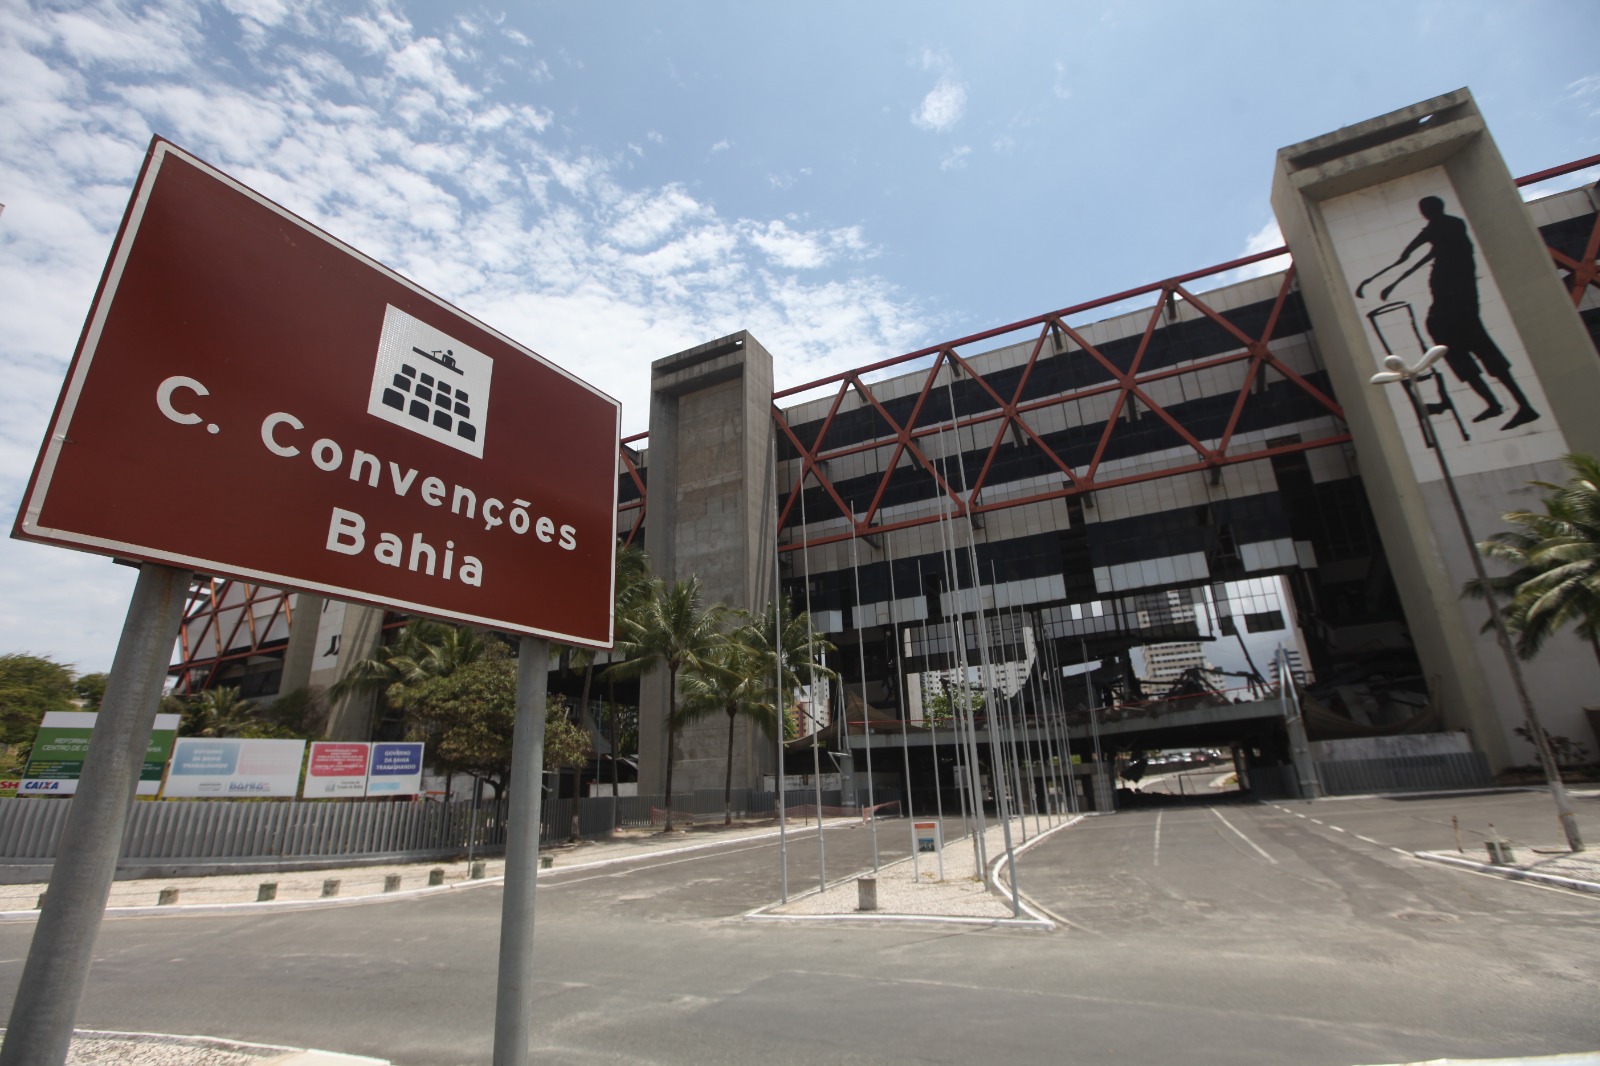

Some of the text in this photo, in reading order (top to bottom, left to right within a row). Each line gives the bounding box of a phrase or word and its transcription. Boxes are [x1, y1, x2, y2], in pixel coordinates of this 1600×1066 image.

[156, 375, 577, 551] C. Convenções
[325, 506, 483, 587] Bahia
[25, 781, 59, 789] CAIXA
